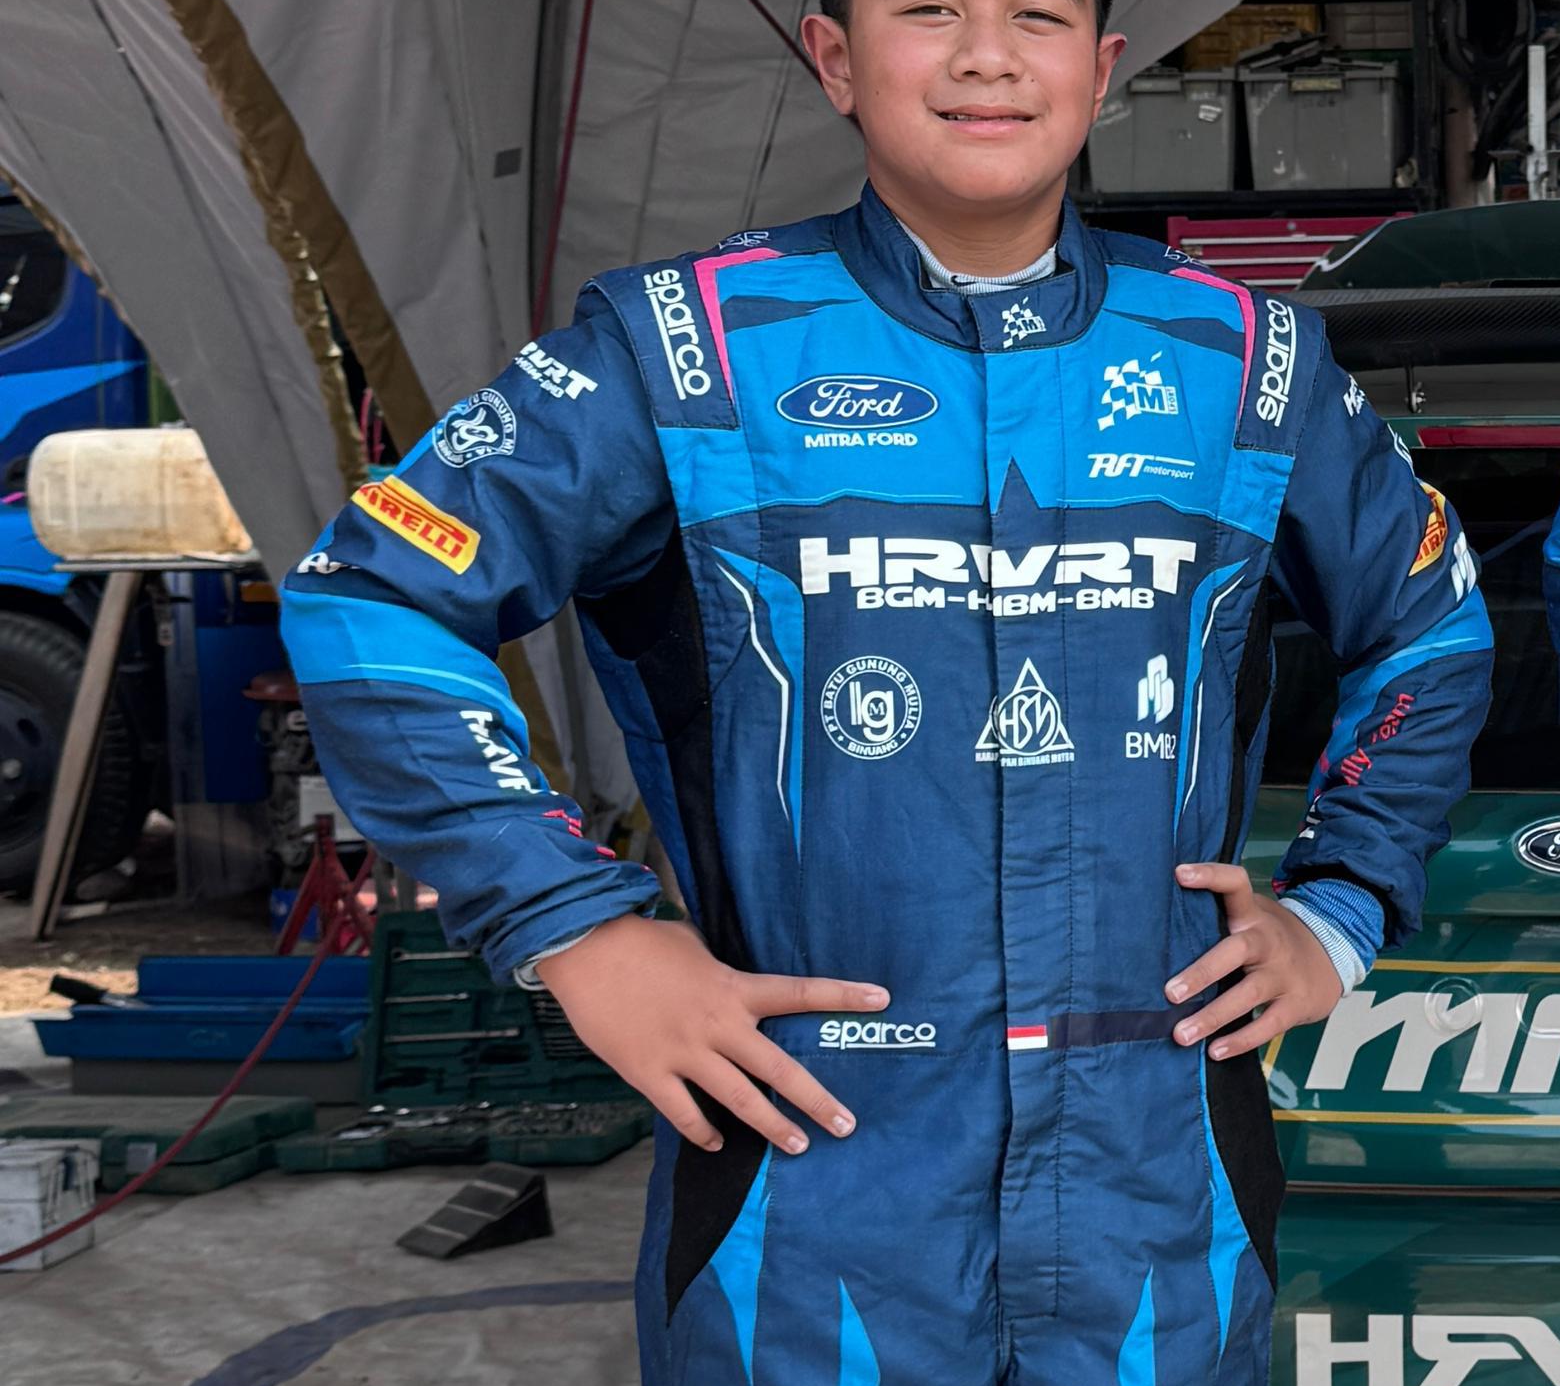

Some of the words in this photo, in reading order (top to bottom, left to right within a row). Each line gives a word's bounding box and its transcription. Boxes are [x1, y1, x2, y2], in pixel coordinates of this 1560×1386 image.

[643, 269, 712, 401] sparco
[1255, 298, 1297, 428] sparco
[809, 381, 904, 418] Ford
[804, 433, 865, 448] MITRA
[867, 432, 918, 447] FORD
[1142, 466, 1195, 481] motorsport
[799, 536, 1198, 596] HRVRT
[845, 658, 907, 683] GUNUNG
[823, 672, 845, 709] BATU
[903, 682, 919, 730] MULIA
[824, 714, 839, 733] PT
[1125, 731, 1177, 760] BMB2
[818, 1019, 937, 1051] sparco
